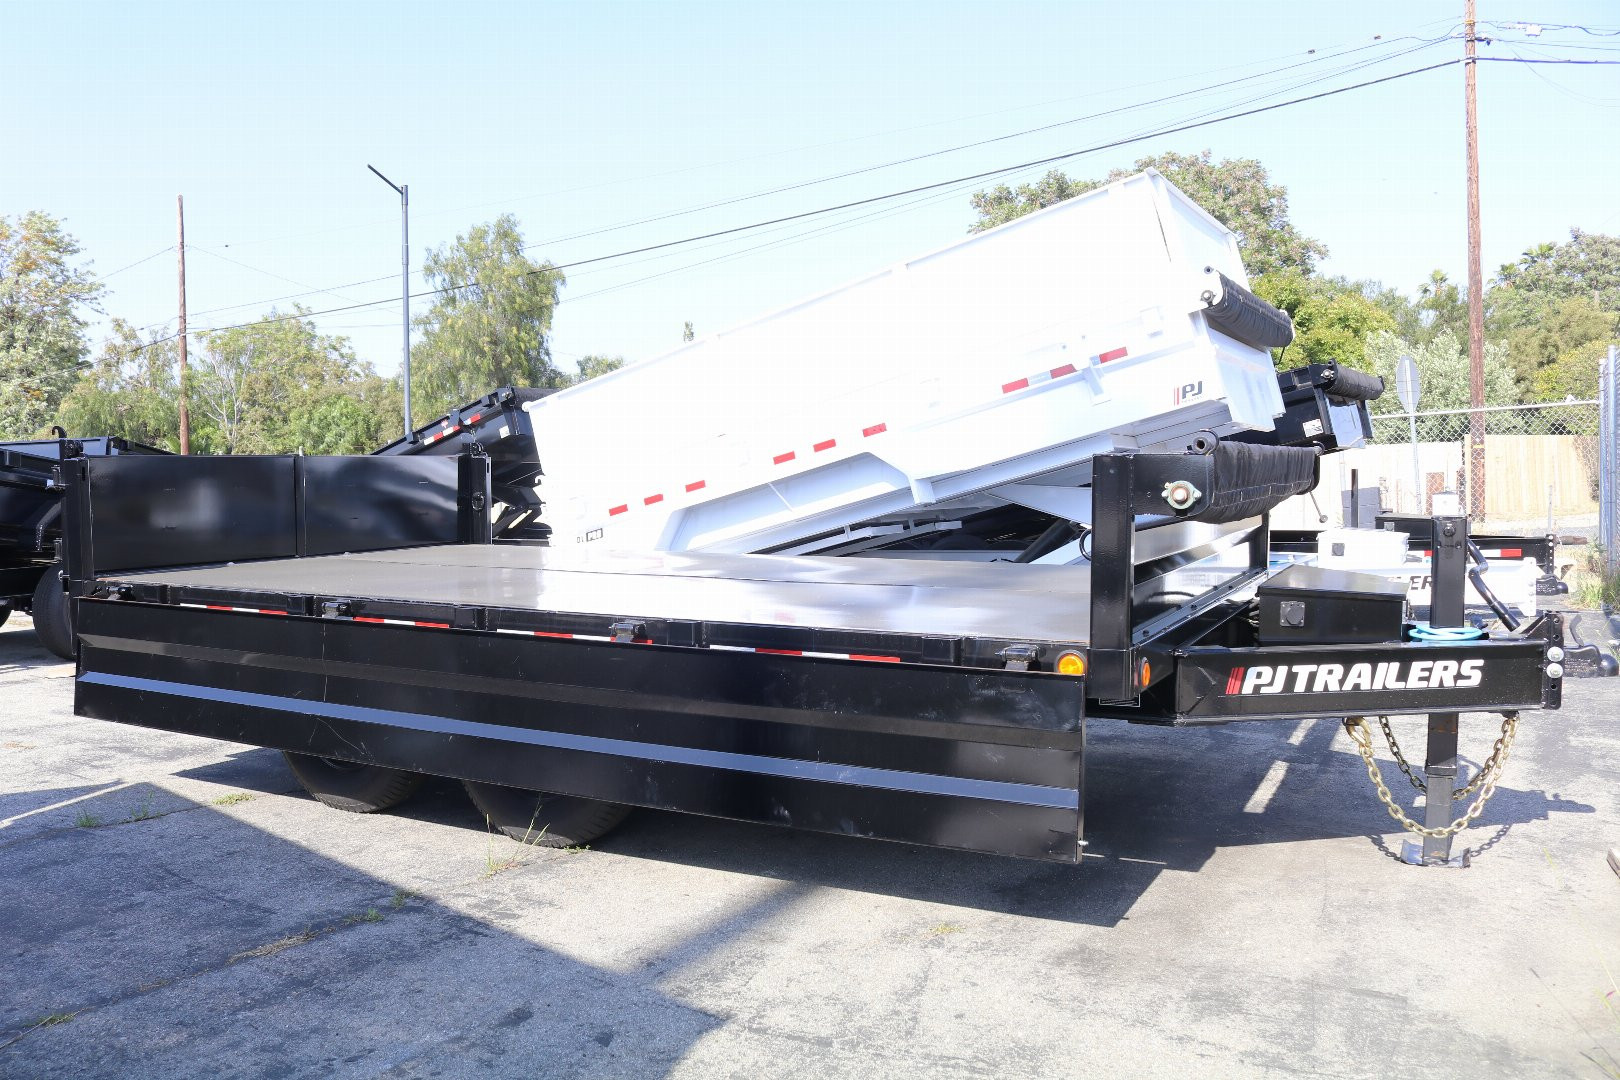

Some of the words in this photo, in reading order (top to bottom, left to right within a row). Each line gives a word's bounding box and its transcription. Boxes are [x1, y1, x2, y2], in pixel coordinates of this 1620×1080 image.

[1182, 380, 1203, 400] PJ
[1242, 666, 1289, 694] PJ
[1291, 659, 1485, 694] TRAILERS
